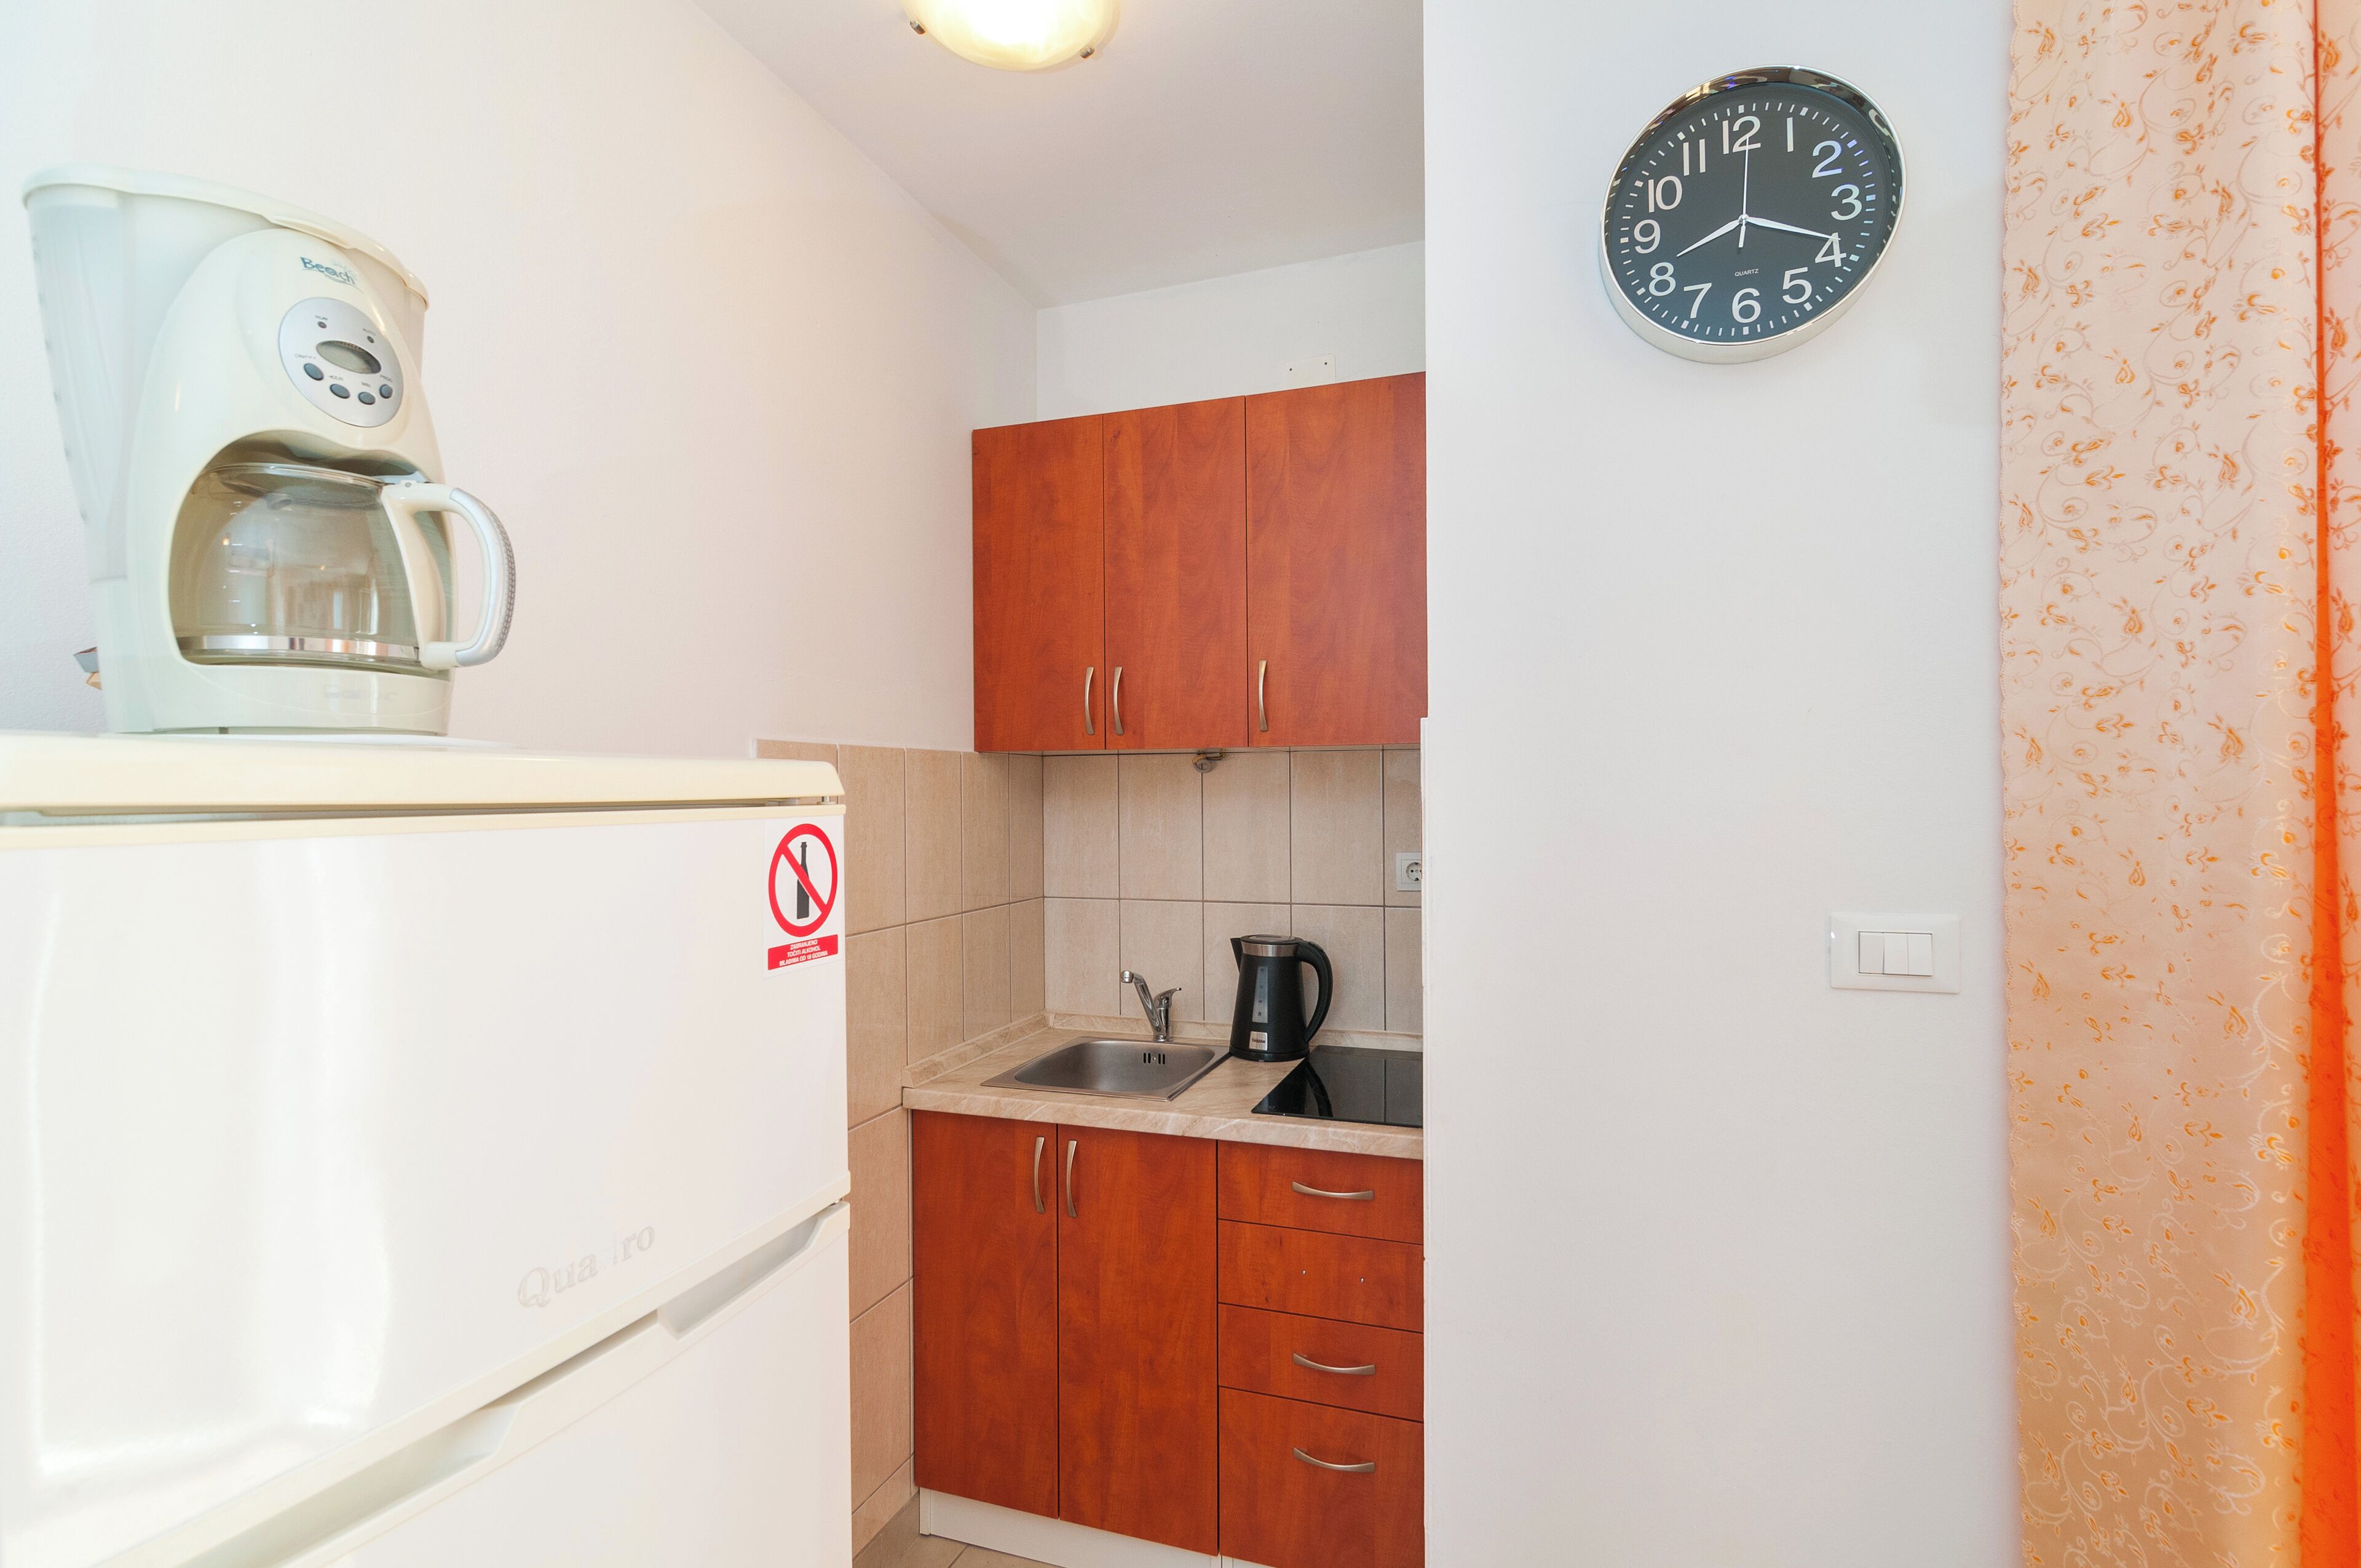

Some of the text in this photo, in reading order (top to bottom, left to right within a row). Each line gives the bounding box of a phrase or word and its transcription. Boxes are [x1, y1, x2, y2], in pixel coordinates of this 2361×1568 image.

[1722, 116, 1761, 154] 12
[1787, 117, 1794, 152] 1
[1683, 138, 1706, 176] 11
[1811, 140, 1843, 178] 2
[1648, 175, 1683, 213] 10
[1830, 184, 1862, 221] 3
[1633, 219, 1661, 255] 9
[1814, 232, 1846, 268] 4
[299, 256, 355, 285] Beach
[1648, 262, 1676, 297] 8
[1734, 268, 1759, 277] QUARTZ
[1782, 267, 1813, 304] 5
[1683, 283, 1712, 319] 7
[1731, 288, 1761, 323] 6
[518, 1226, 655, 1308] Quaro
